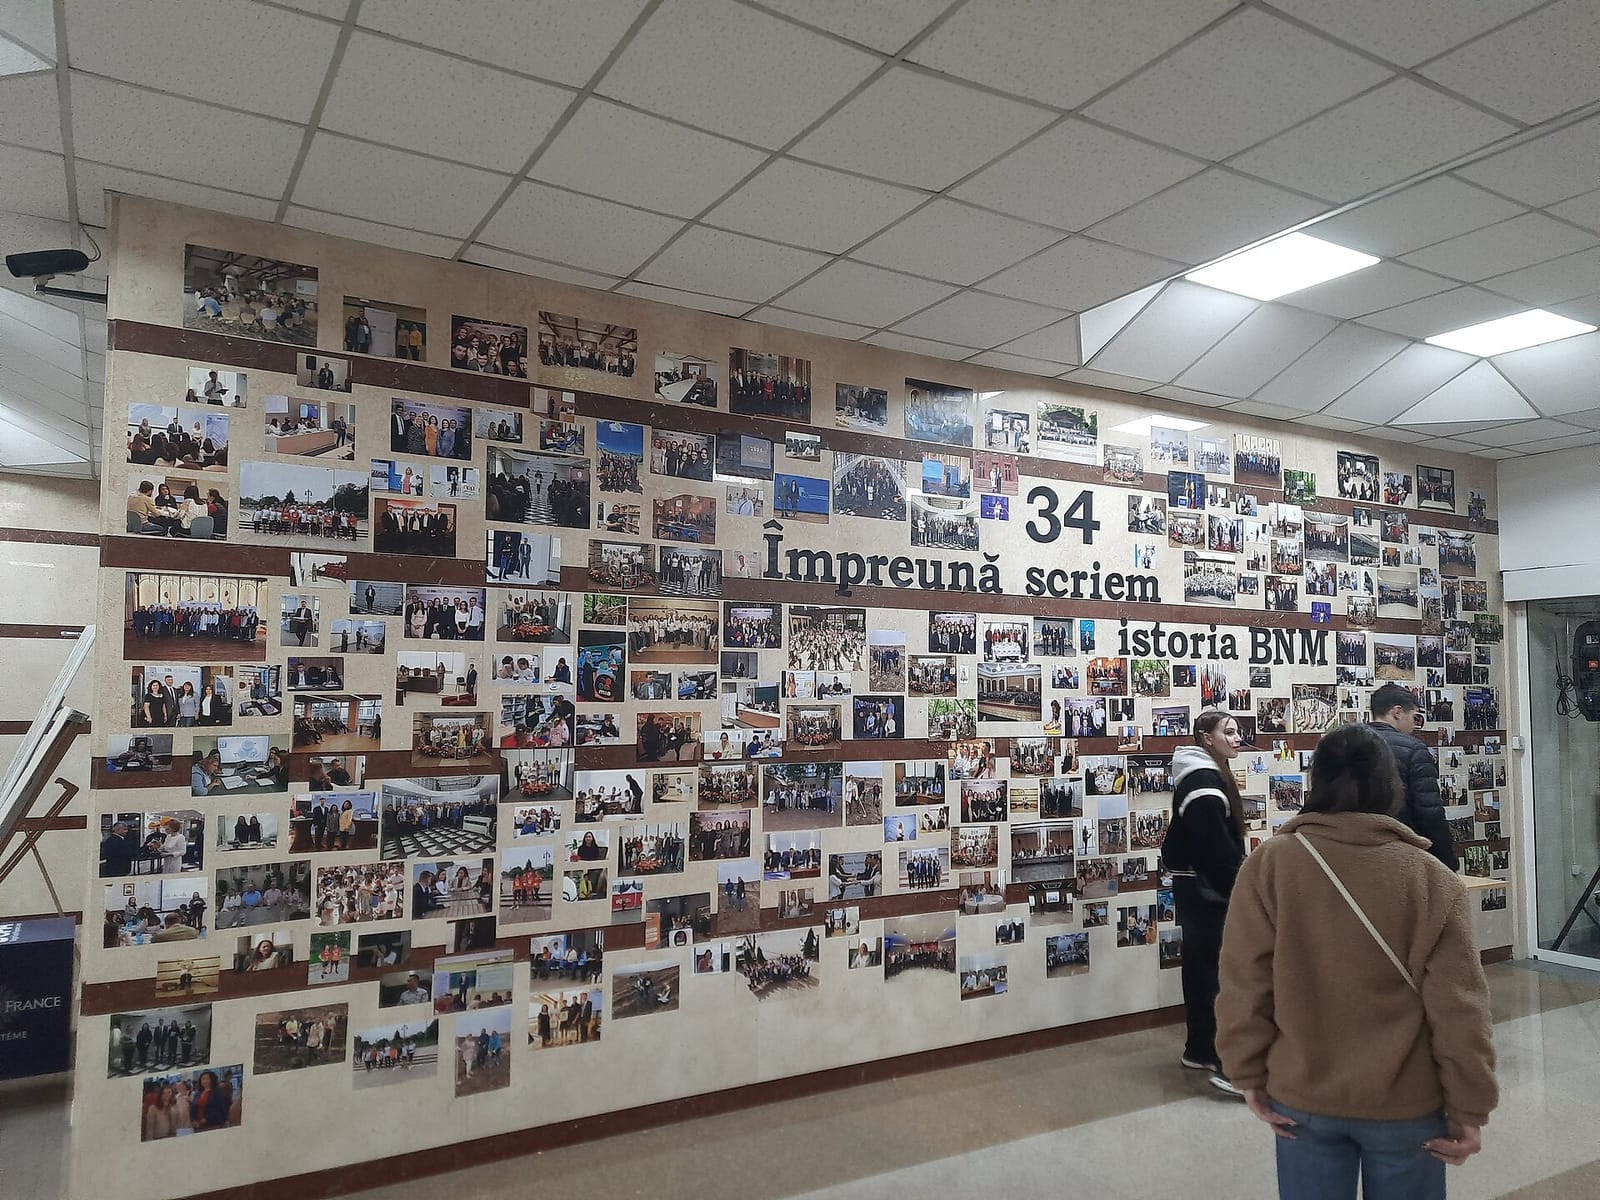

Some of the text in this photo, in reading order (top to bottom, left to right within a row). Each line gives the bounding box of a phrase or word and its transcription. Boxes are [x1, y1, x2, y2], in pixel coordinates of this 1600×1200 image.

[1025, 485, 1101, 545] 34
[762, 518, 1161, 602] Împreună scriem
[1118, 617, 1328, 666] istoria BNM
[5, 996, 62, 1014] FRANCE
